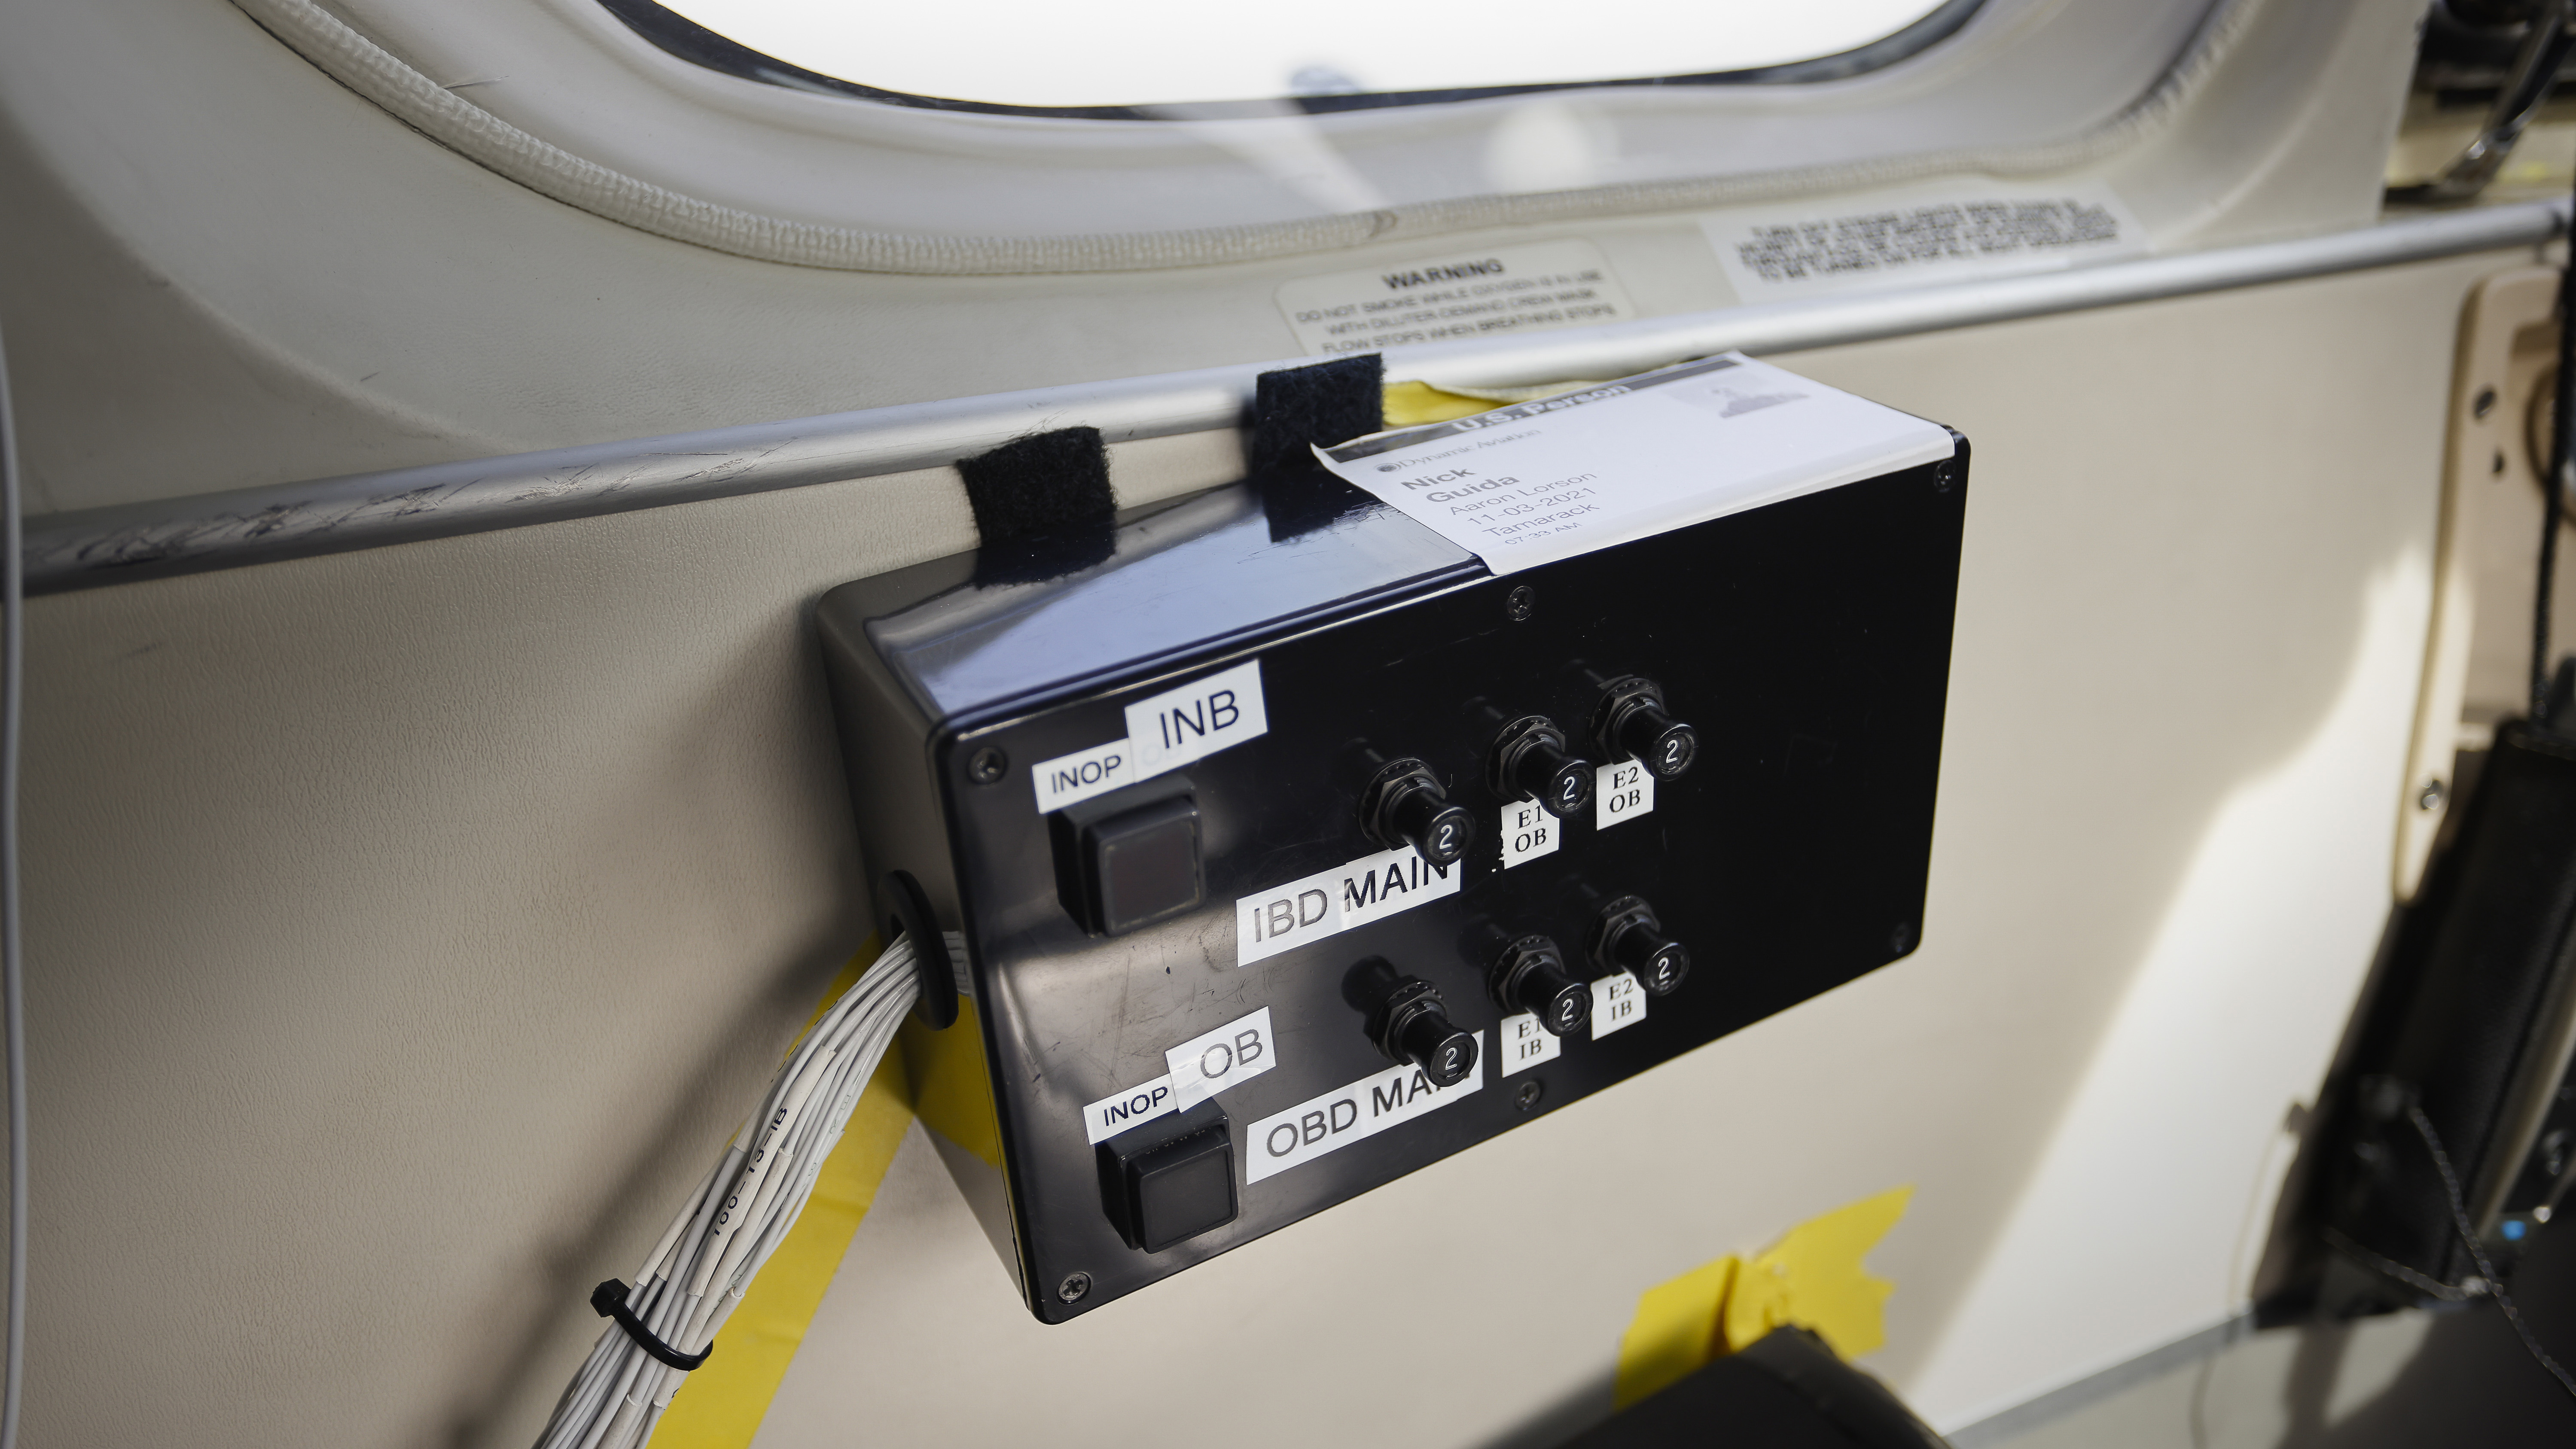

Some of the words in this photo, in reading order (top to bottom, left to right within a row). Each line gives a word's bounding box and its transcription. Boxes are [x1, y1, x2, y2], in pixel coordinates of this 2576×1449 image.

[1382, 258, 1504, 289] WARNING
[1452, 411, 1523, 431] U.S.
[1521, 384, 1632, 415] Person
[1399, 445, 1473, 467] Dynamic
[1476, 429, 1542, 449] Aviation
[1400, 469, 1477, 490] Nick
[1426, 476, 1521, 502] Guida
[1450, 494, 1516, 515] Aaron
[1517, 473, 1597, 496] Lorson
[1467, 487, 1596, 525] 11-03-2021
[1482, 504, 1600, 536] Tamarack
[1505, 530, 1551, 545] 07:33
[1555, 522, 1583, 533] AM
[1160, 689, 1239, 749] INB
[1666, 740, 1678, 763] 2
[1051, 755, 1121, 794] INOP
[1613, 766, 1639, 790] E2
[1563, 776, 1575, 801] 2
[1610, 788, 1640, 813] OB
[1518, 804, 1543, 829] E1
[1439, 825, 1453, 849] 2
[1515, 828, 1546, 852] OB
[1255, 888, 1327, 942] IBD
[1658, 957, 1670, 980] 2
[1609, 979, 1633, 1001] E2
[1561, 998, 1573, 1021] 2
[1612, 1000, 1632, 1022] IB
[1518, 1018, 1542, 1039] E1
[1200, 1029, 1262, 1079] OB
[1445, 1047, 1457, 1070] 2
[1520, 1039, 1541, 1061] IB
[1104, 1086, 1168, 1127] INOP
[1266, 1099, 1357, 1158] OBD
[1372, 1069, 1470, 1117] MA
